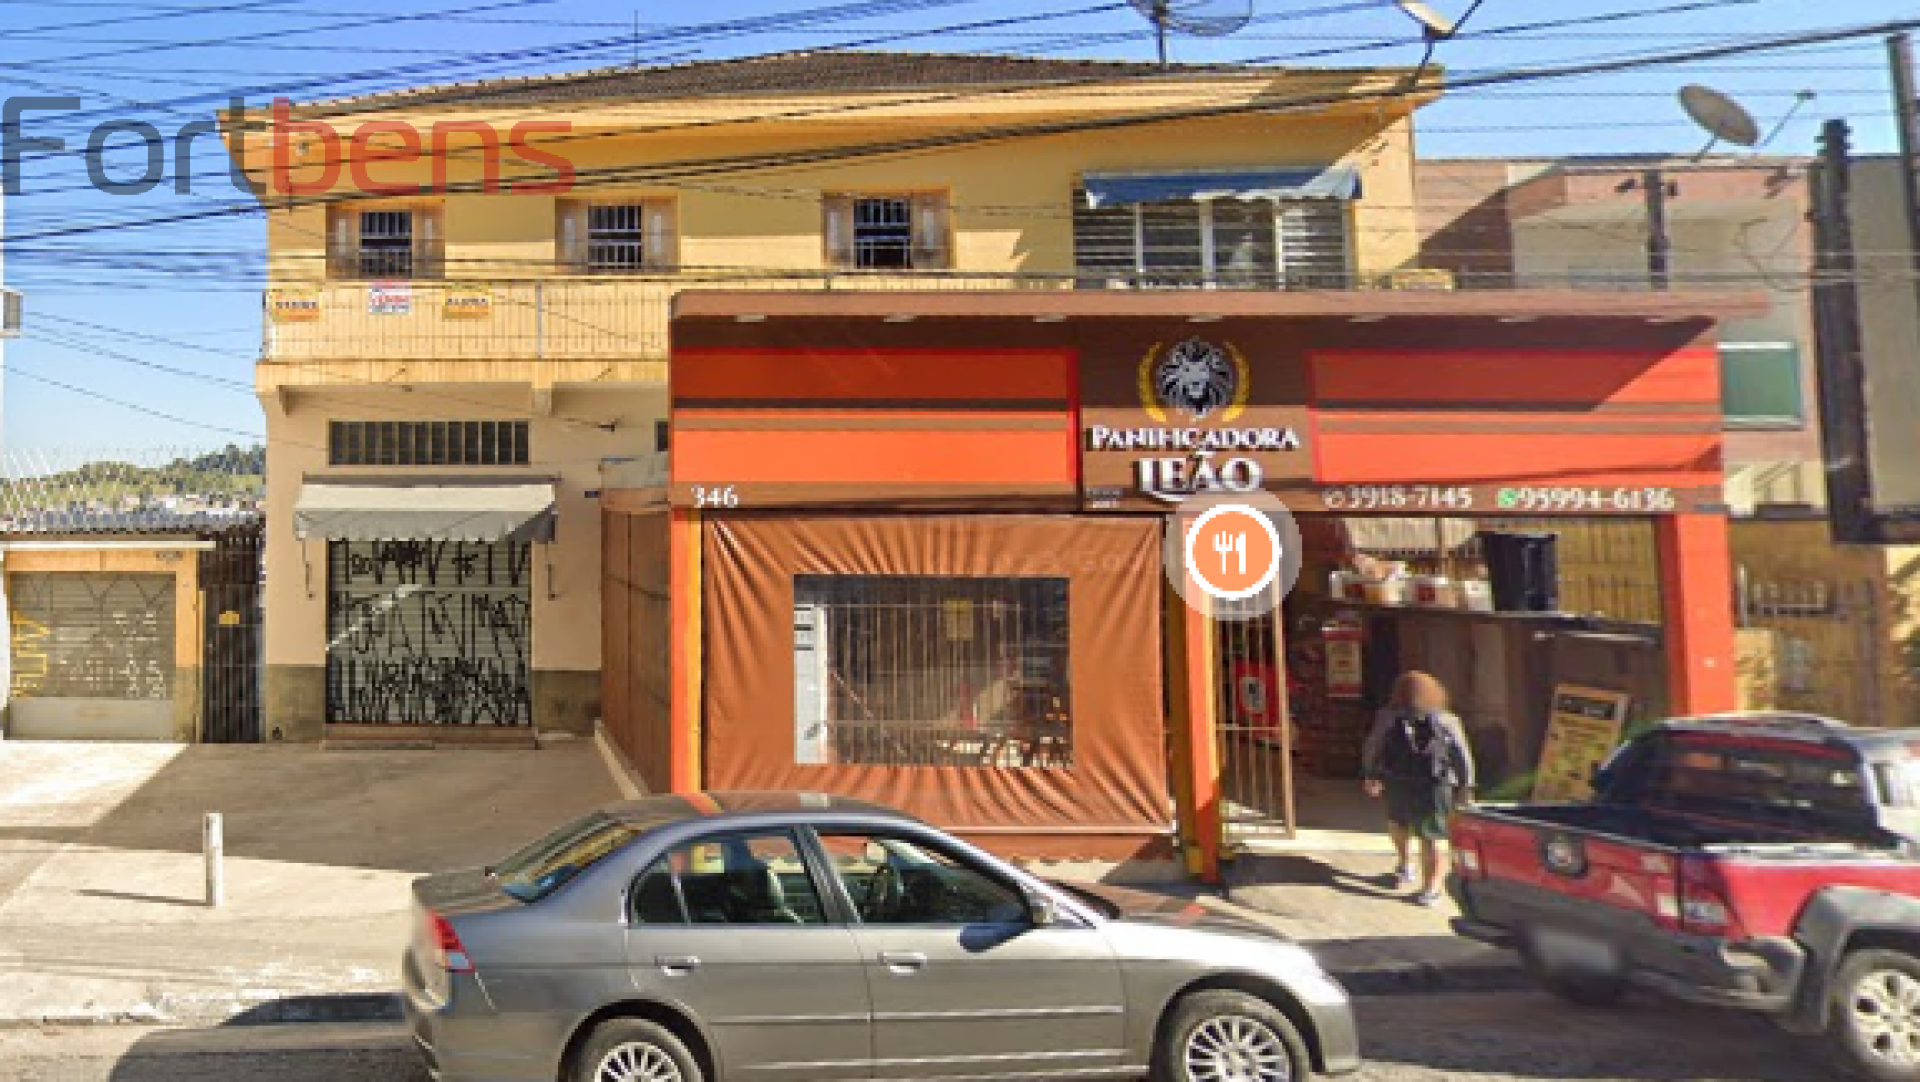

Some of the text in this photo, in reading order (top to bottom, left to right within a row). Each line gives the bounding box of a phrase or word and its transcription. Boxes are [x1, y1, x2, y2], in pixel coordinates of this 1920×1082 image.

[1137, 450, 1263, 500] LEÃO
[691, 485, 738, 508] 346
[1349, 487, 1675, 509] 3918-7145 95994-6136
